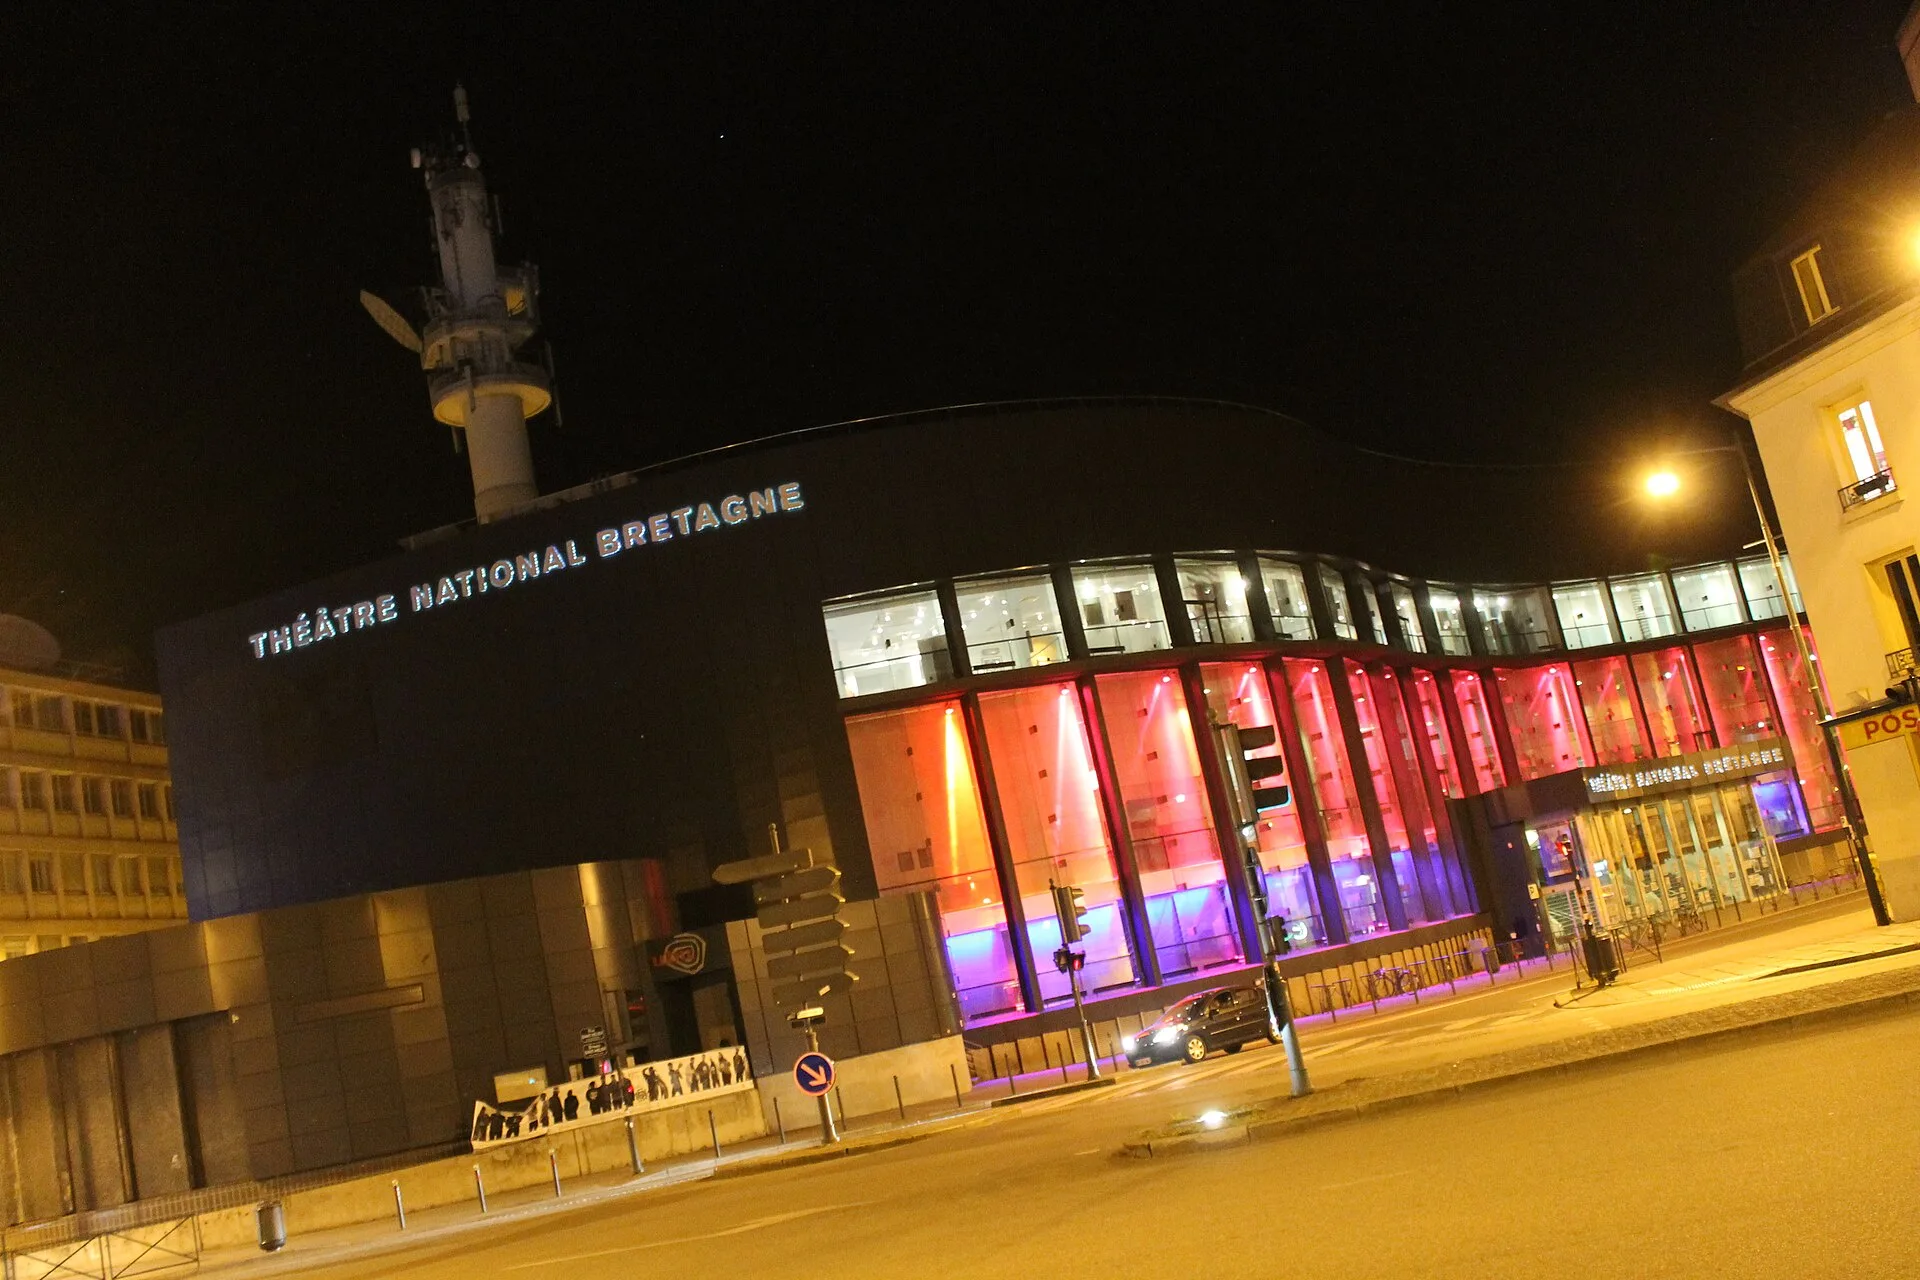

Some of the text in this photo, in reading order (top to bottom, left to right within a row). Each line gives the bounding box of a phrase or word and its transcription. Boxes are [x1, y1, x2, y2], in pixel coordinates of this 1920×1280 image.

[248, 481, 805, 660] THÉÂTRE NATIONAL BRETAGNE
